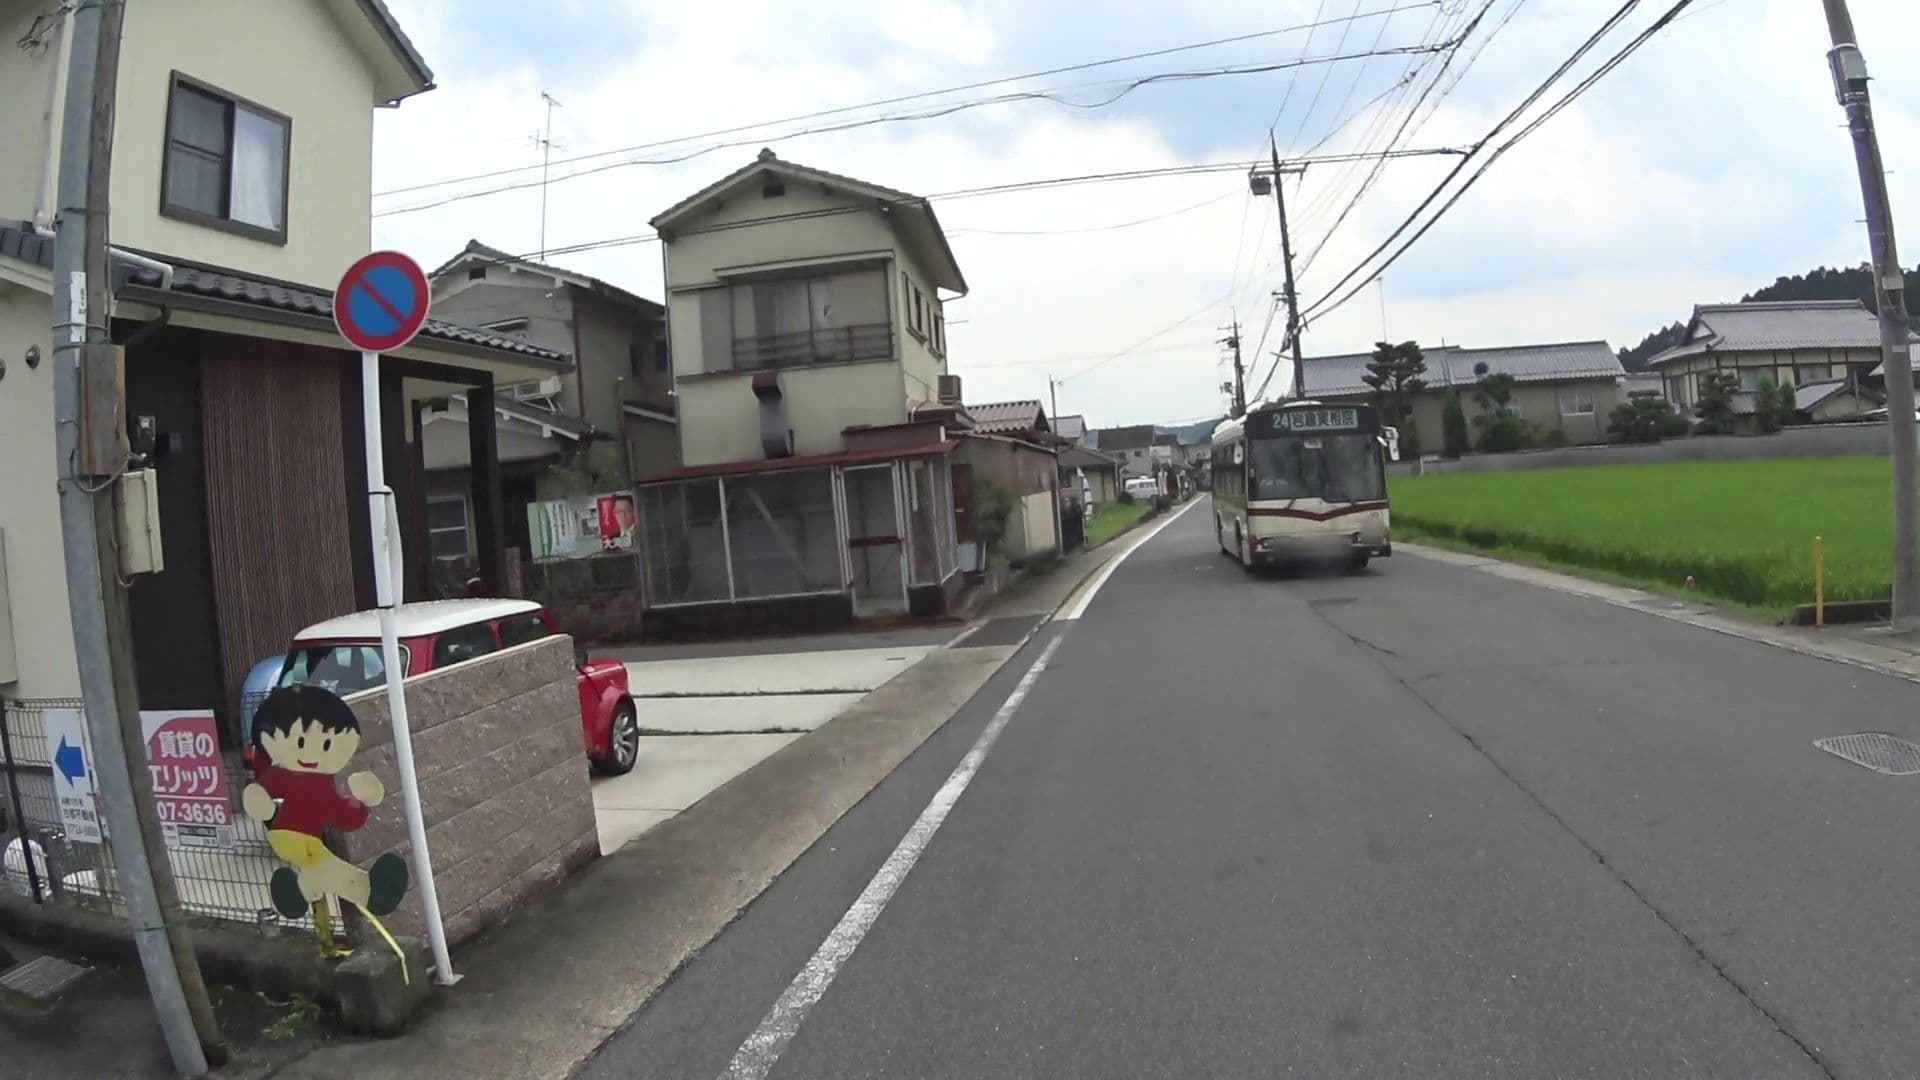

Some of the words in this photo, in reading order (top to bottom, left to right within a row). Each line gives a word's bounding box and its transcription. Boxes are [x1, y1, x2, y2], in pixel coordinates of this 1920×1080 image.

[1273, 413, 1288, 429] 24
[159, 731, 215, 758] 賃貸の
[149, 765, 218, 794] エリッツ
